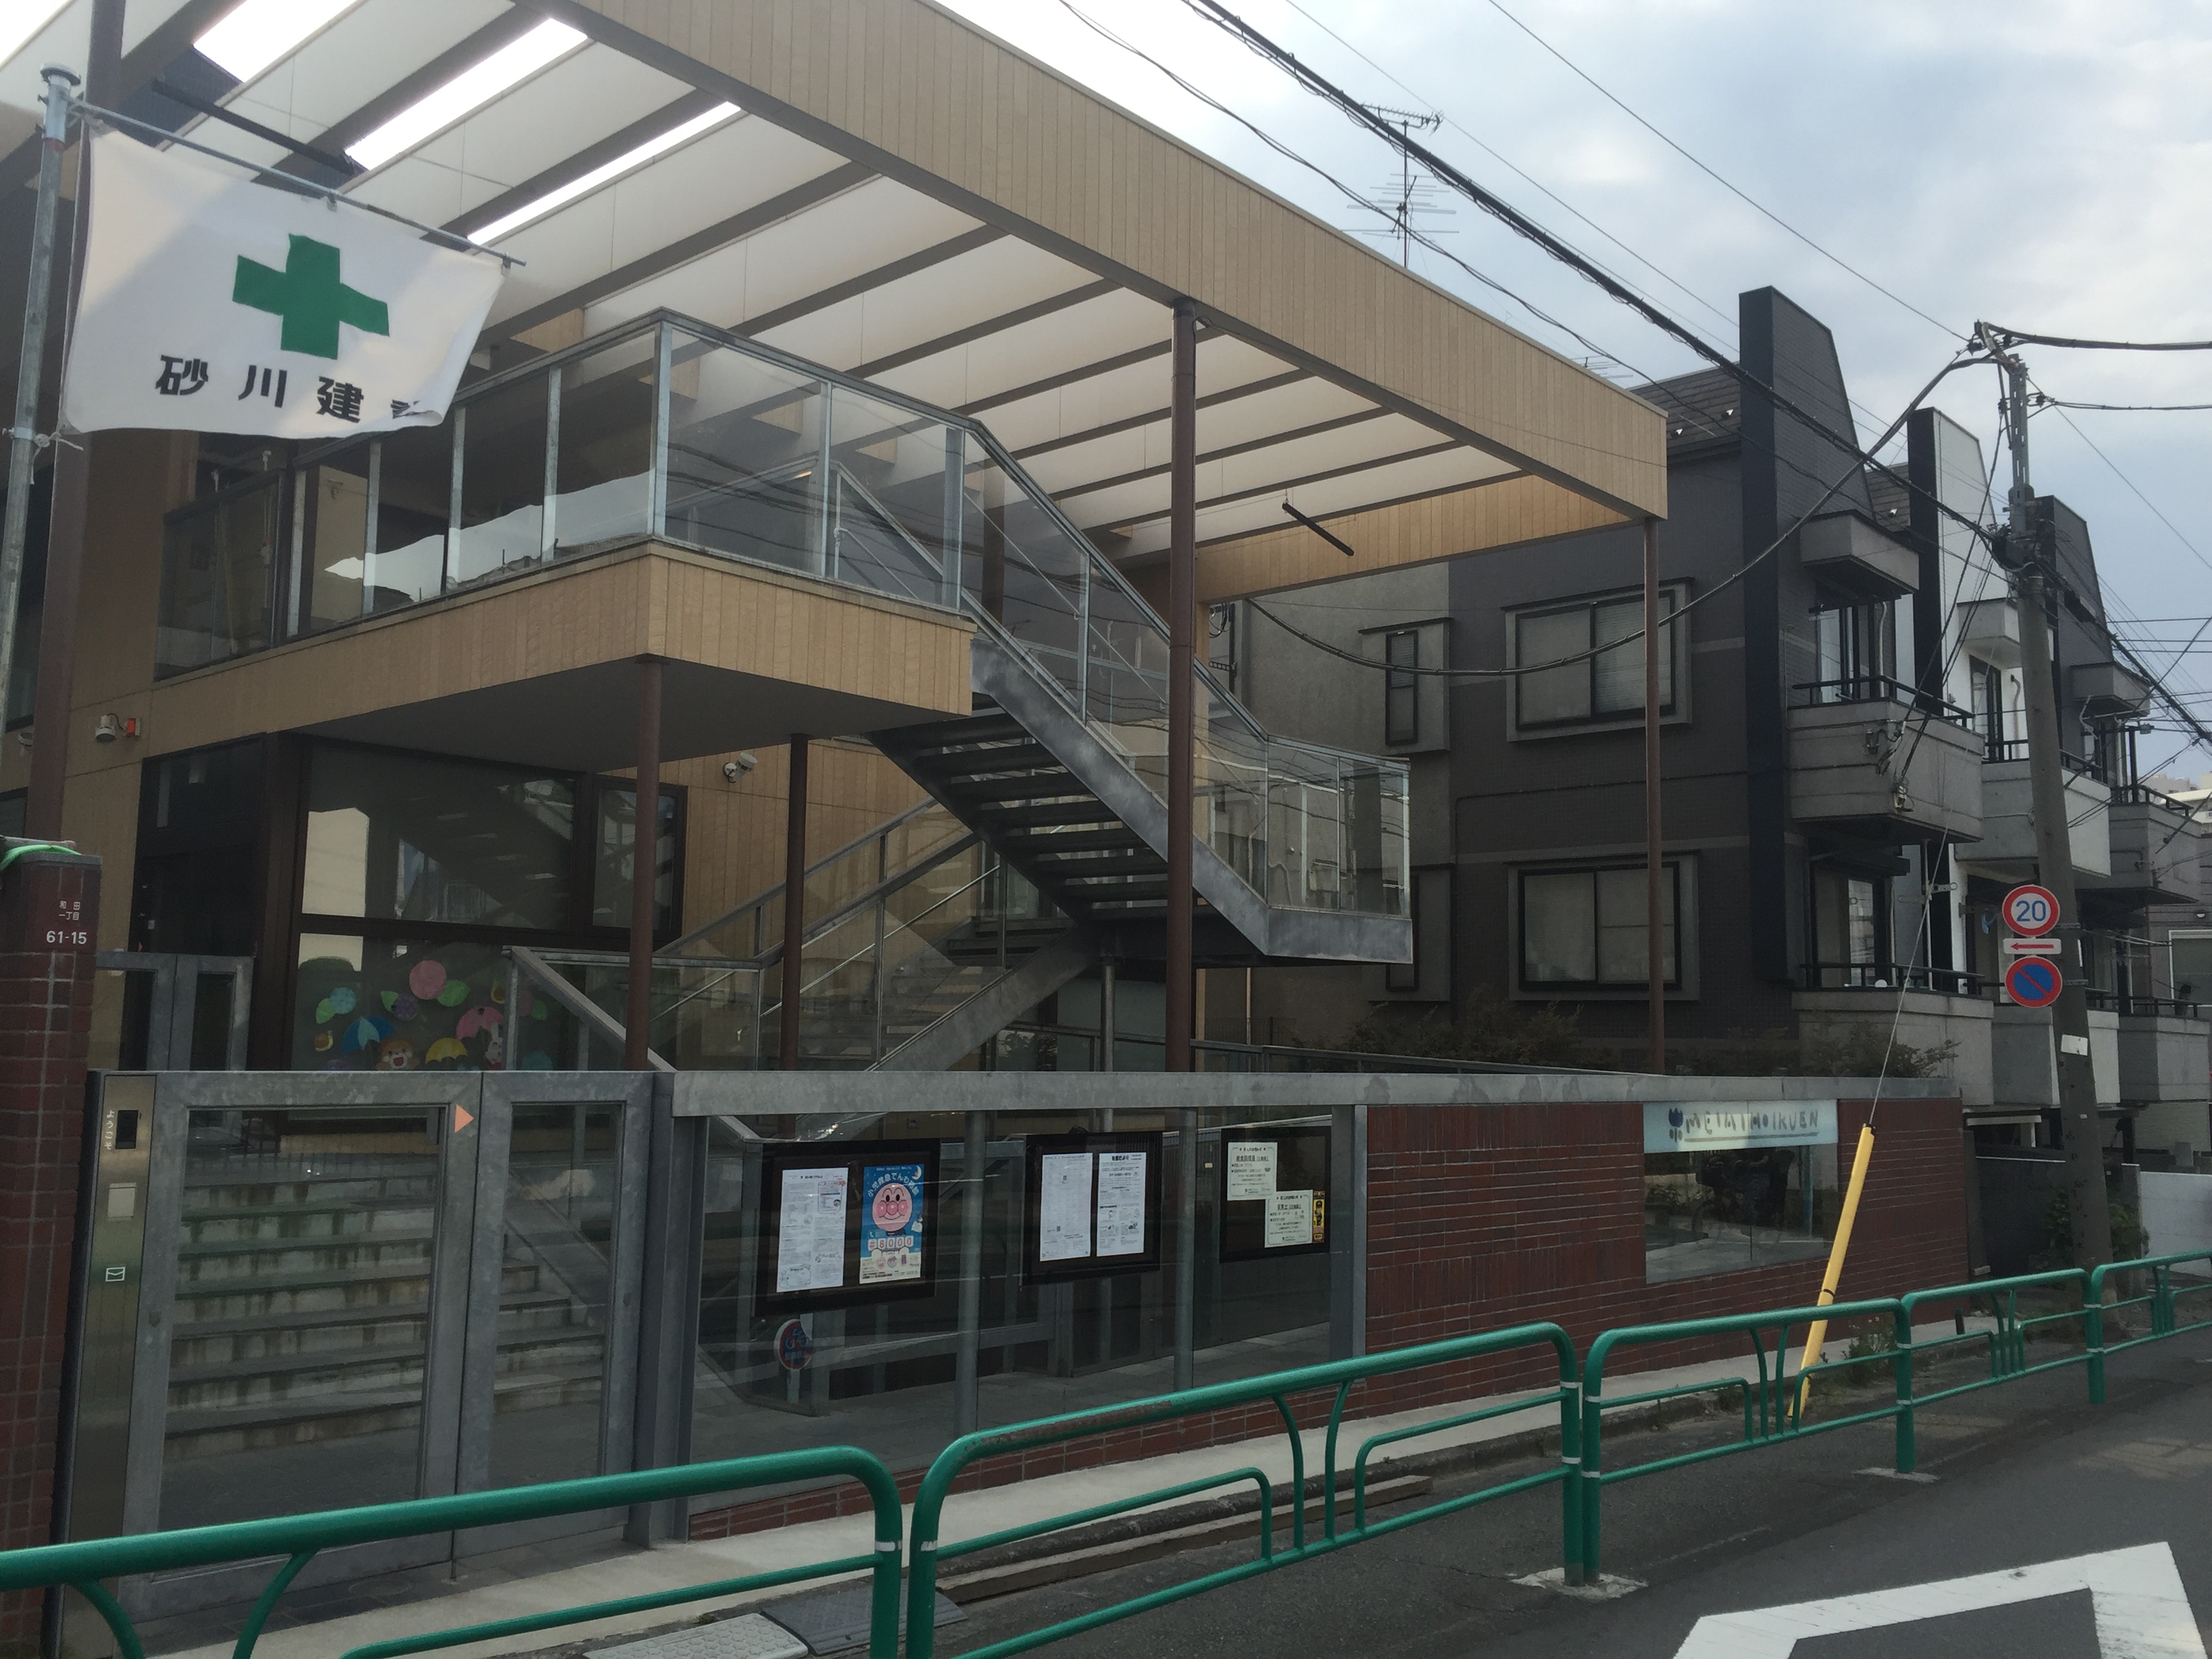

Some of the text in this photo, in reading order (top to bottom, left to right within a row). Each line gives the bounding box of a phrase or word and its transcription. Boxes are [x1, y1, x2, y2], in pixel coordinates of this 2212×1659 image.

[59, 900, 81, 910] 和田
[2015, 899, 2047, 922] 20
[58, 911, 79, 920] 一丁目
[46, 930, 87, 945] 61-15
[104, 1109, 115, 1150] ようこそ
